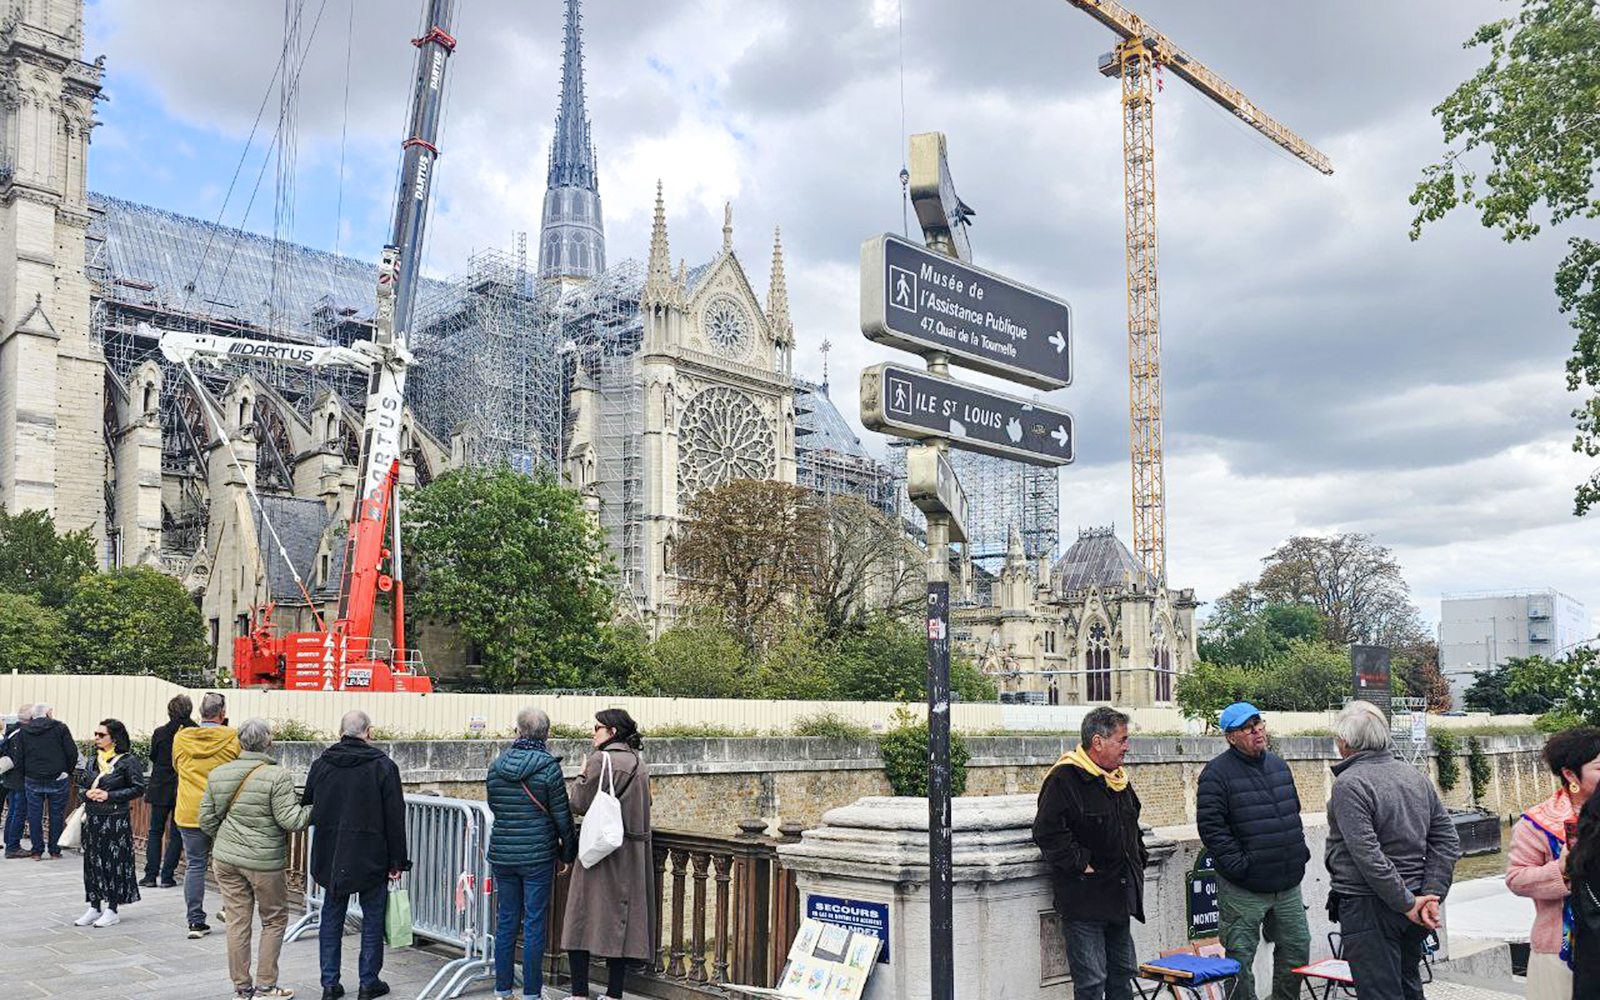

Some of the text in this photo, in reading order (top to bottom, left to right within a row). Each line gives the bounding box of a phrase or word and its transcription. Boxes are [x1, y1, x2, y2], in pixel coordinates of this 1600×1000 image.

[430, 51, 442, 90] DARTUS
[414, 155, 429, 200] DARTUS
[920, 262, 984, 300] Musée de
[920, 289, 1028, 340] l'Assistance Publique
[241, 342, 314, 362] DARTUS
[936, 321, 957, 339] Quai
[958, 329, 969, 343] de
[970, 331, 979, 346] la
[980, 335, 1017, 357] Tournelle
[915, 392, 937, 414] ILE
[964, 404, 1002, 429] LOUIS
[1205, 883, 1218, 895] QU
[815, 902, 879, 918] SECOURS
